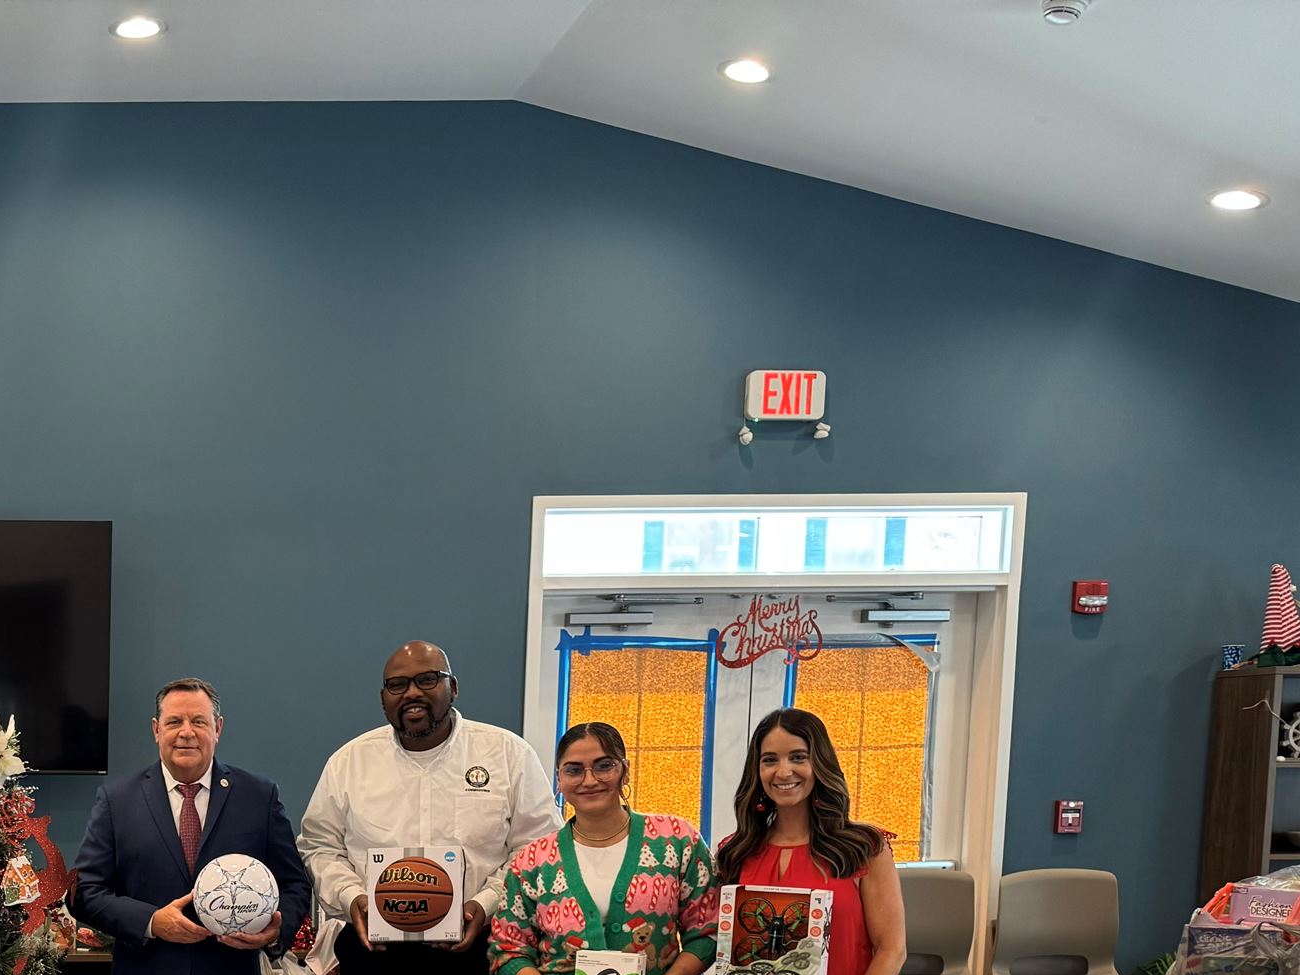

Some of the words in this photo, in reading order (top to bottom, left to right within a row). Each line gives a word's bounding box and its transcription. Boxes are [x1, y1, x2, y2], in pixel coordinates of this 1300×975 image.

[763, 372, 817, 415] EXIT
[740, 594, 799, 628] Merry
[716, 608, 822, 668] Christmas
[379, 867, 439, 886] Wilson
[209, 895, 259, 913] Champion
[383, 898, 428, 914] NCAA
[1249, 895, 1292, 908] Fashion
